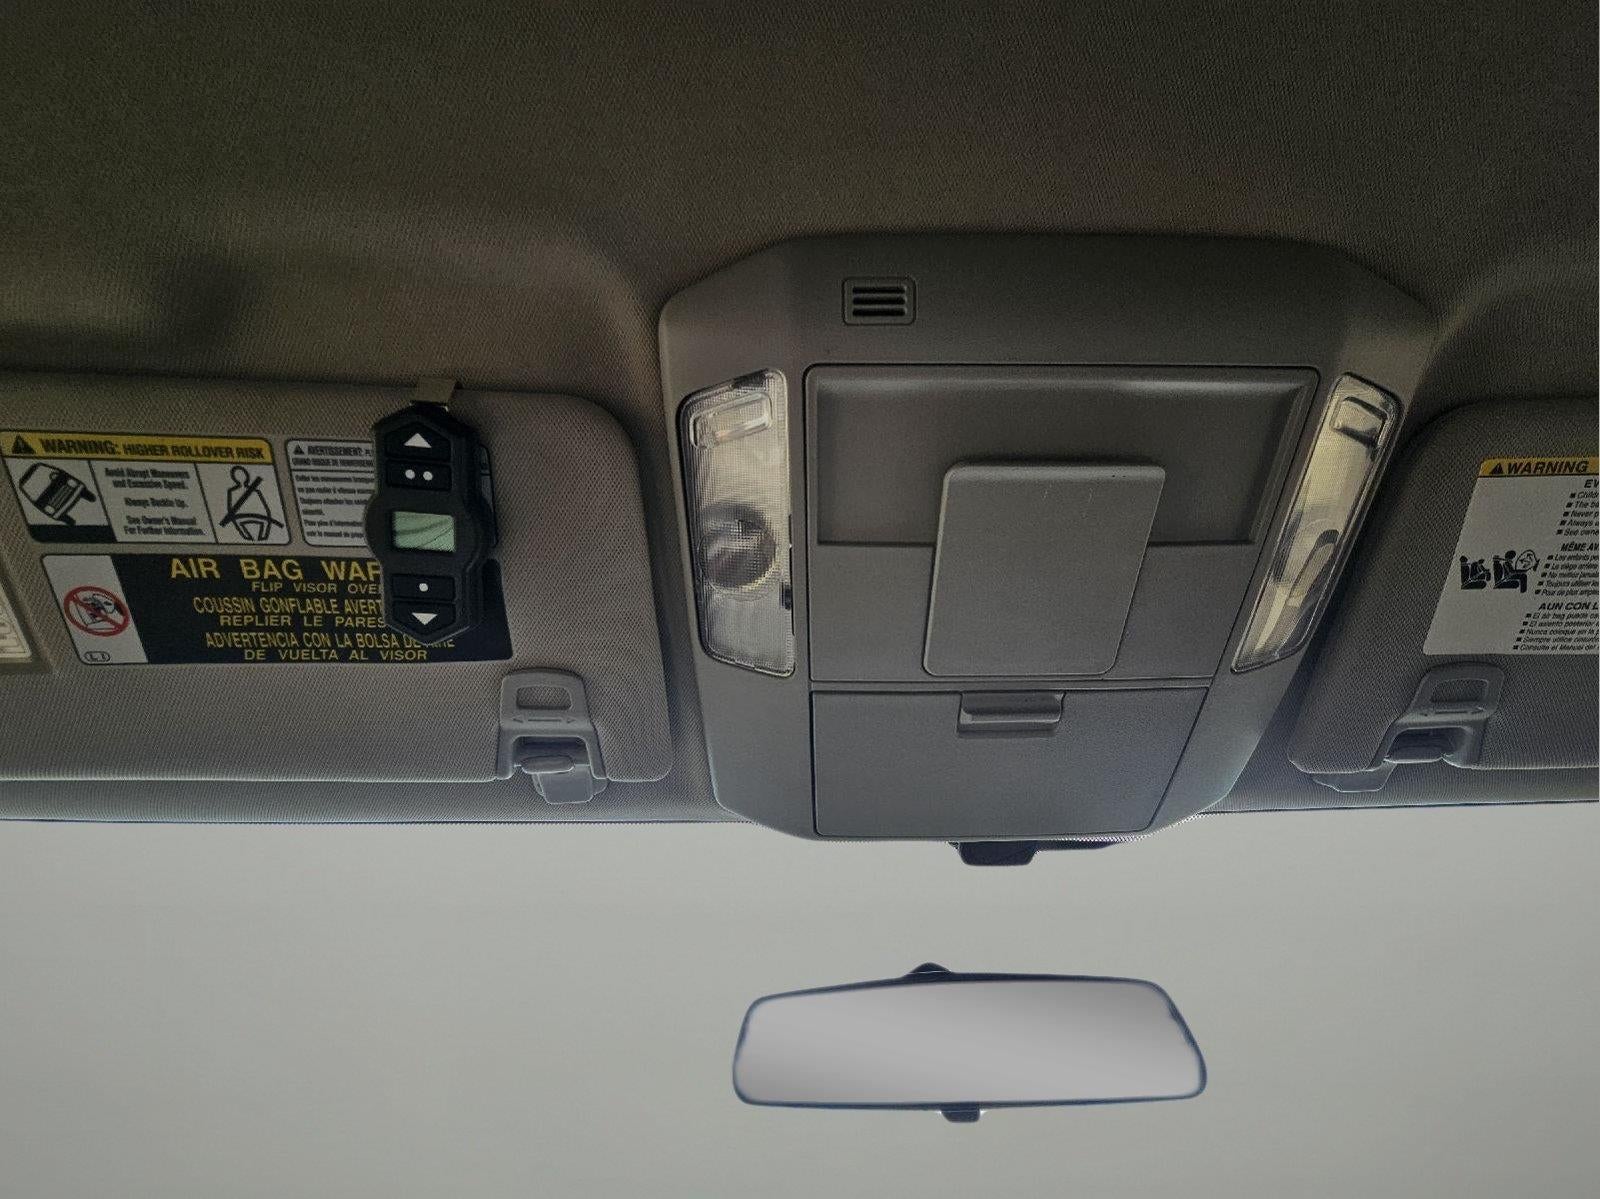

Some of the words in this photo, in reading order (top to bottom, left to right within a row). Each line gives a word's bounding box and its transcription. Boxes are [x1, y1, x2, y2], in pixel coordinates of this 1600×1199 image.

[122, 443, 168, 457] HIGHER
[170, 445, 234, 458] ROLLOVER
[236, 447, 264, 460] RISK
[1508, 461, 1589, 474] WARNING
[170, 557, 221, 579] AIR
[239, 558, 305, 581] BAG
[251, 582, 283, 593] FLIP
[292, 582, 337, 594] VISOR
[192, 597, 256, 615] COUSSIN
[259, 597, 340, 615] GONFLABLE
[1565, 602, 1591, 611] CON
[219, 614, 292, 627] REPLIER
[303, 615, 324, 628] LE
[204, 631, 299, 649] ADVERTENCIA
[303, 631, 332, 649] CON
[335, 631, 353, 649] LA
[355, 632, 402, 649] BOLSA
[243, 649, 267, 661] DE
[277, 649, 339, 661] VUELTA
[348, 649, 370, 661] AL
[379, 649, 428, 661] VISOR
